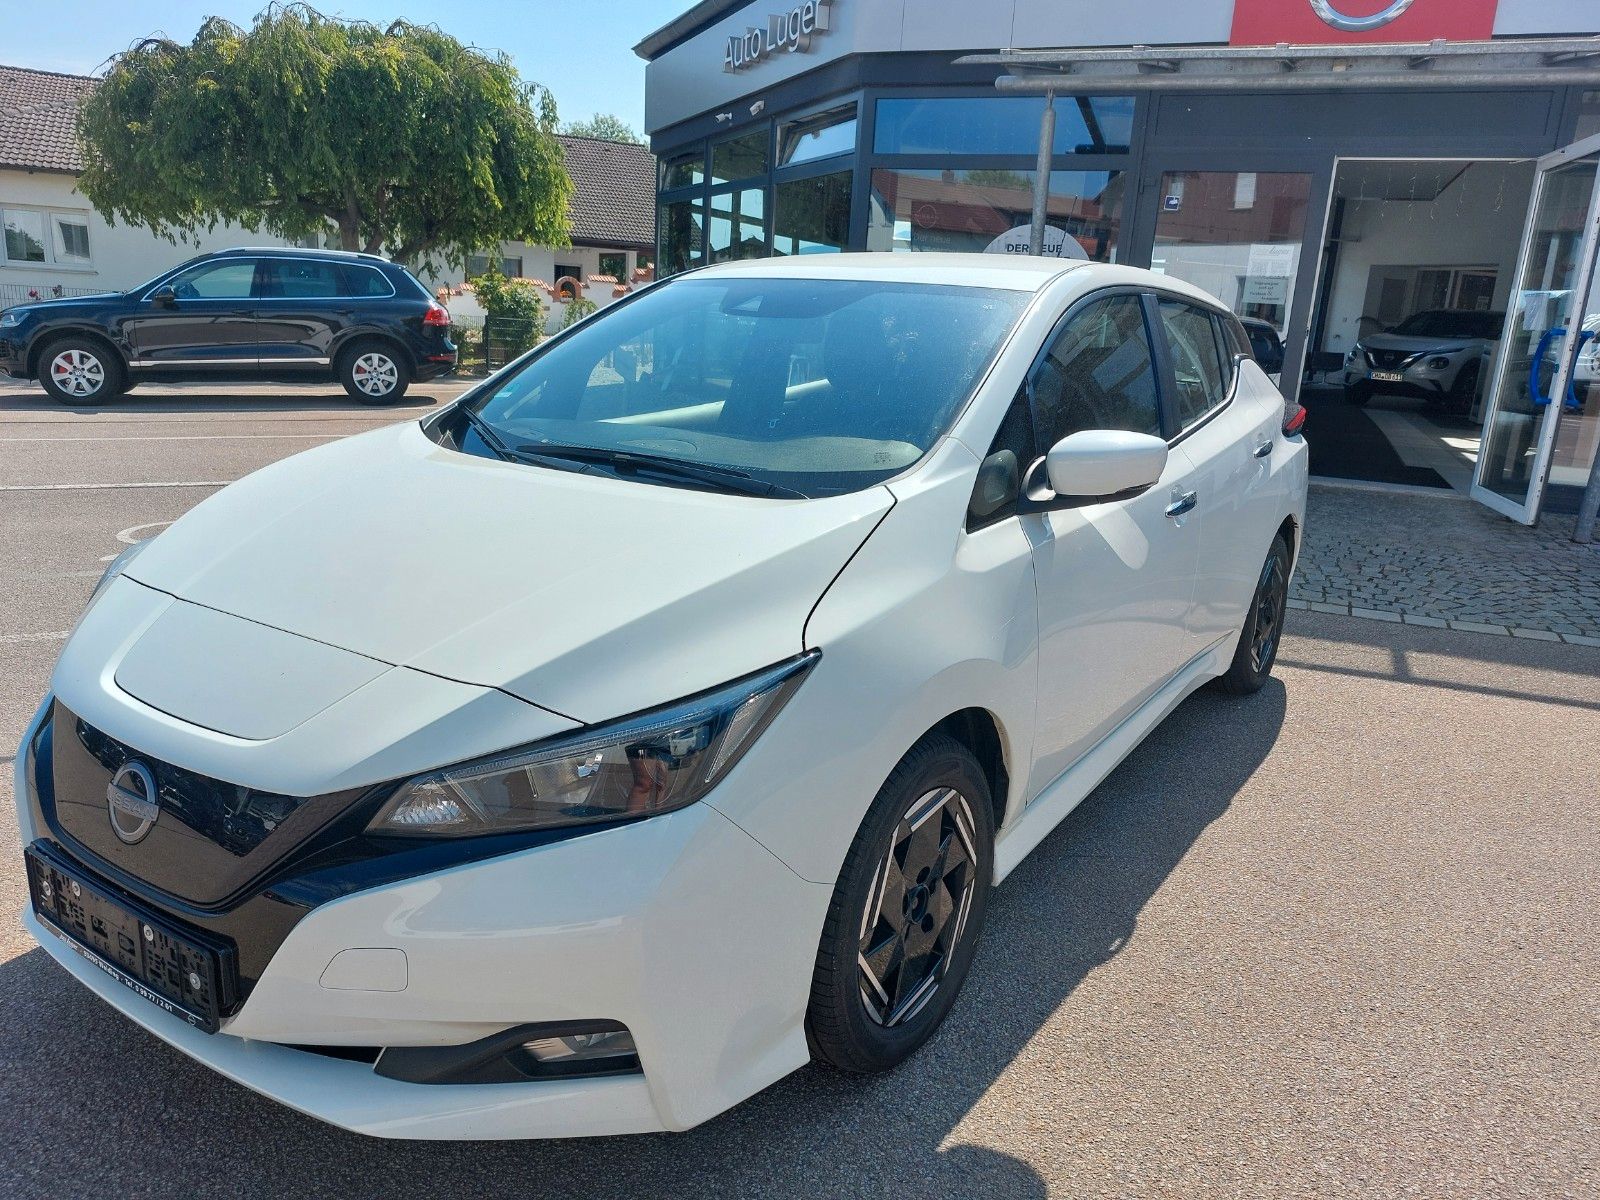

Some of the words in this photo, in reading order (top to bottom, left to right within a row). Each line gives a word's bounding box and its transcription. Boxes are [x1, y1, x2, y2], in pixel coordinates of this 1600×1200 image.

[724, 28, 761, 71] Auto
[766, 0, 823, 52] Luger
[1006, 243, 1030, 252] DER
[1042, 244, 1063, 253] EUE
[108, 785, 156, 820] NISSAN
